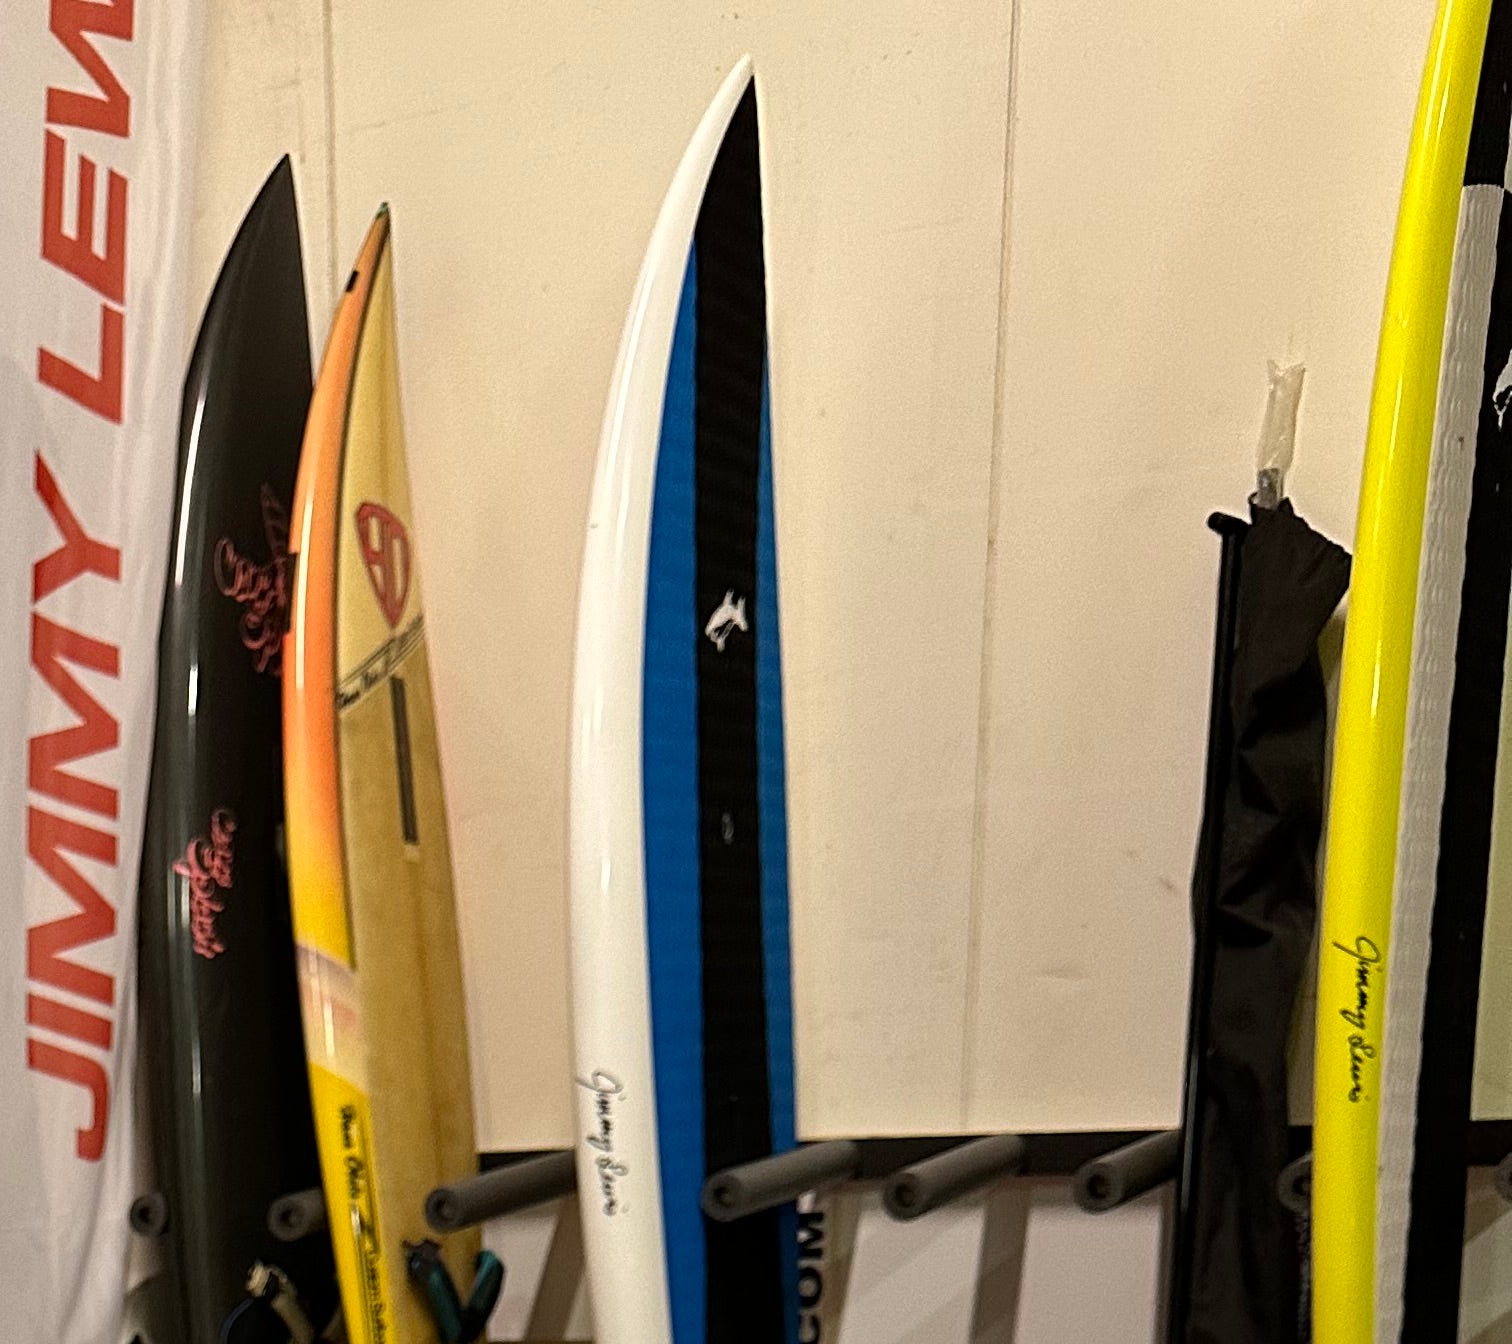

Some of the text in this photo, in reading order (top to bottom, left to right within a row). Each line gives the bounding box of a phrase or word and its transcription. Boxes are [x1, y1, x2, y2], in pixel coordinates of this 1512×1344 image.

[26, 449, 123, 1163] JIMMY
[1333, 935, 1384, 1030] Jimmy
[576, 1069, 626, 1153] Jimmy
